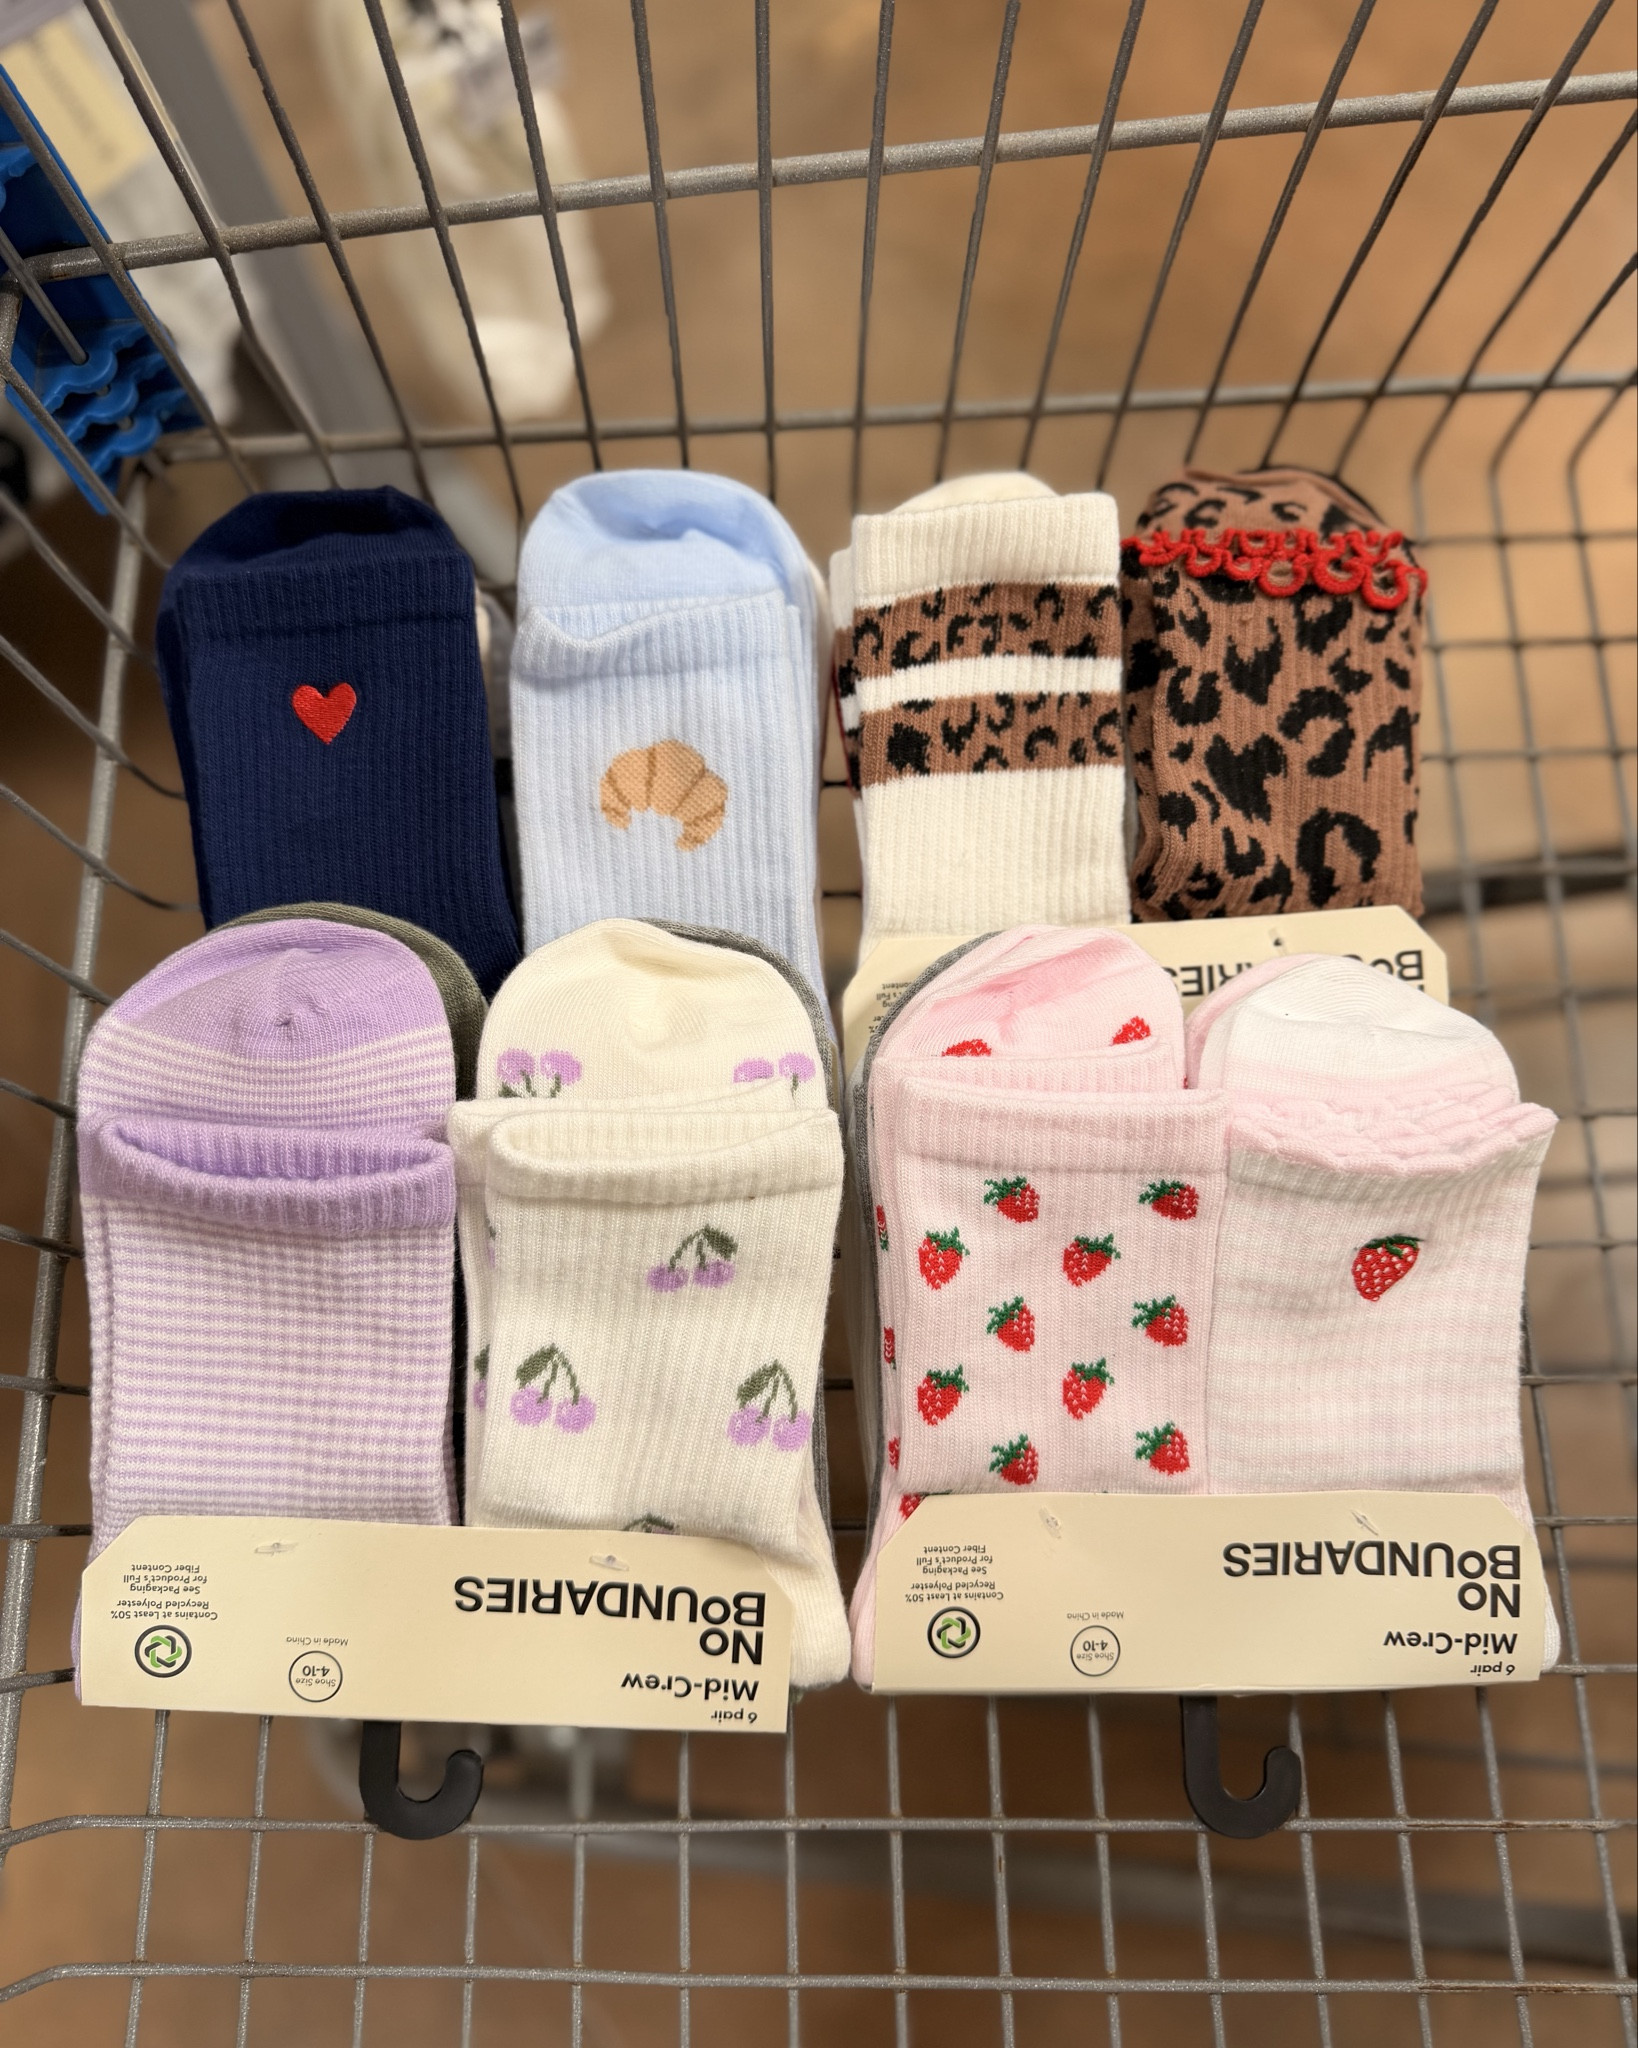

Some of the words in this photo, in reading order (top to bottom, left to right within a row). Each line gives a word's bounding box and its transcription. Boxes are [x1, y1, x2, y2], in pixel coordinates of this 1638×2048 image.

[882, 982, 911, 990] ontent
[923, 1545, 961, 1554] Content
[963, 1544, 986, 1554] Fiber
[916, 1557, 933, 1566] Full
[935, 1555, 978, 1565] Product's
[980, 1555, 993, 1564] for
[131, 1564, 172, 1573] Content
[174, 1564, 200, 1574] Fiber
[922, 1566, 969, 1576] Packaging
[971, 1566, 987, 1575] See
[123, 1574, 141, 1583] Full
[144, 1575, 190, 1584] Product's
[193, 1575, 208, 1584] for
[129, 1583, 180, 1594] Packaging
[911, 1580, 953, 1591] Polyester
[955, 1579, 996, 1590] Recycled
[183, 1585, 201, 1594] See
[905, 1593, 924, 1602] 50%
[926, 1593, 950, 1602] Least
[953, 1592, 962, 1600] at
[964, 1591, 1004, 1601] Contains
[117, 1598, 162, 1609] Polyester
[165, 1598, 209, 1610] Recycled
[111, 1610, 131, 1619] 50%
[134, 1610, 160, 1619] Least
[175, 1611, 218, 1620] Contains
[1066, 1612, 1091, 1620] China
[1092, 1611, 1100, 1619] in
[1101, 1611, 1124, 1619] Made
[286, 1636, 312, 1646] China
[313, 1637, 322, 1646] in
[323, 1637, 349, 1646] Made
[1082, 1640, 1108, 1651] 4-10
[1383, 1630, 1518, 1655] Mid-Crew
[1076, 1652, 1093, 1661] Size
[1094, 1651, 1115, 1661] Shoe
[302, 1665, 331, 1677] 4-10
[1469, 1661, 1502, 1676] pair
[1505, 1664, 1515, 1676] 6
[295, 1677, 314, 1686] Size
[315, 1678, 336, 1687] Shoe
[620, 1672, 759, 1702] Mid-Crew
[710, 1708, 744, 1724] pair
[747, 1711, 758, 1724] 6
